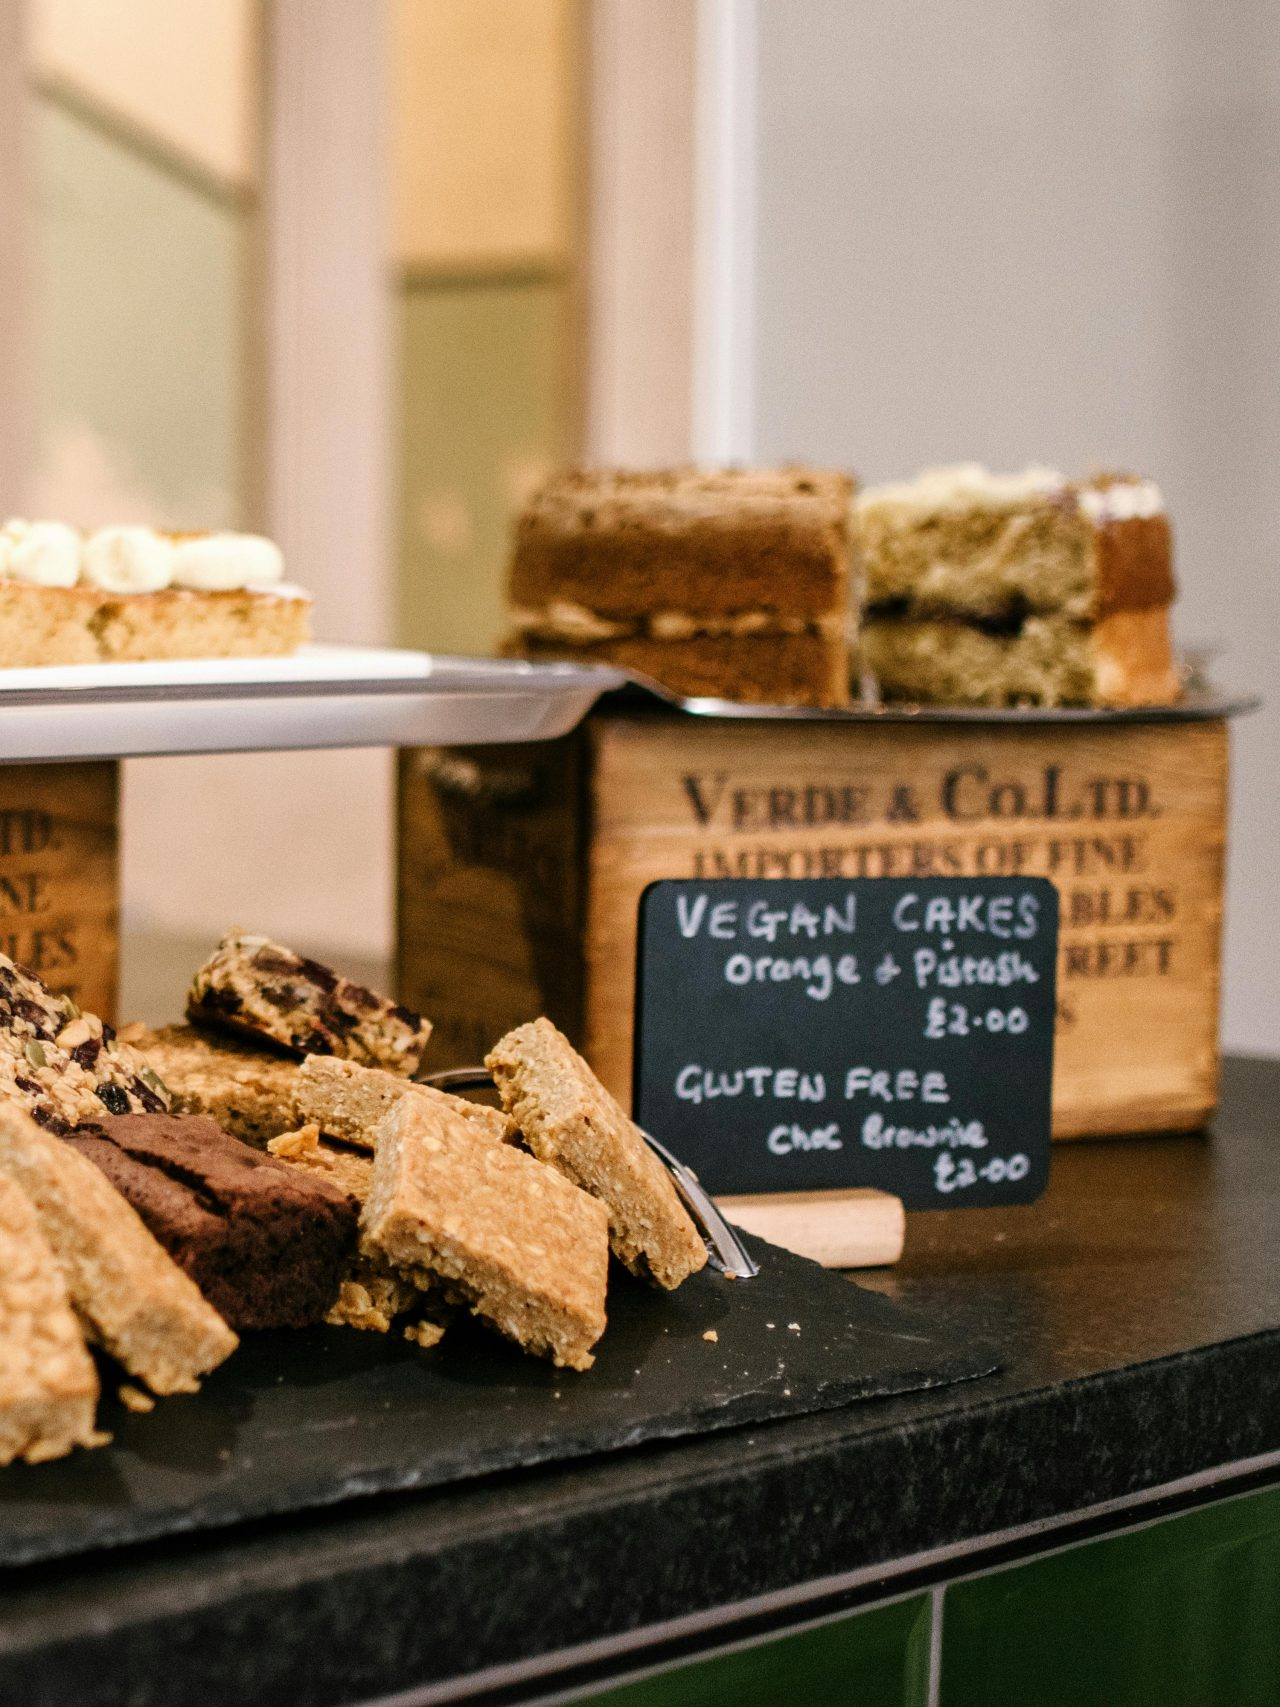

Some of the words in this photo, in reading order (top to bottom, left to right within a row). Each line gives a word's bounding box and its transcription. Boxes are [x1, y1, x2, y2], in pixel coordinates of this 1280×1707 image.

[675, 893, 857, 942] VEGAN
[893, 893, 1042, 940] CAKES
[1066, 938, 1173, 978] REET
[675, 1064, 827, 1104] GLUTEN
[844, 1066, 951, 1103] FREE
